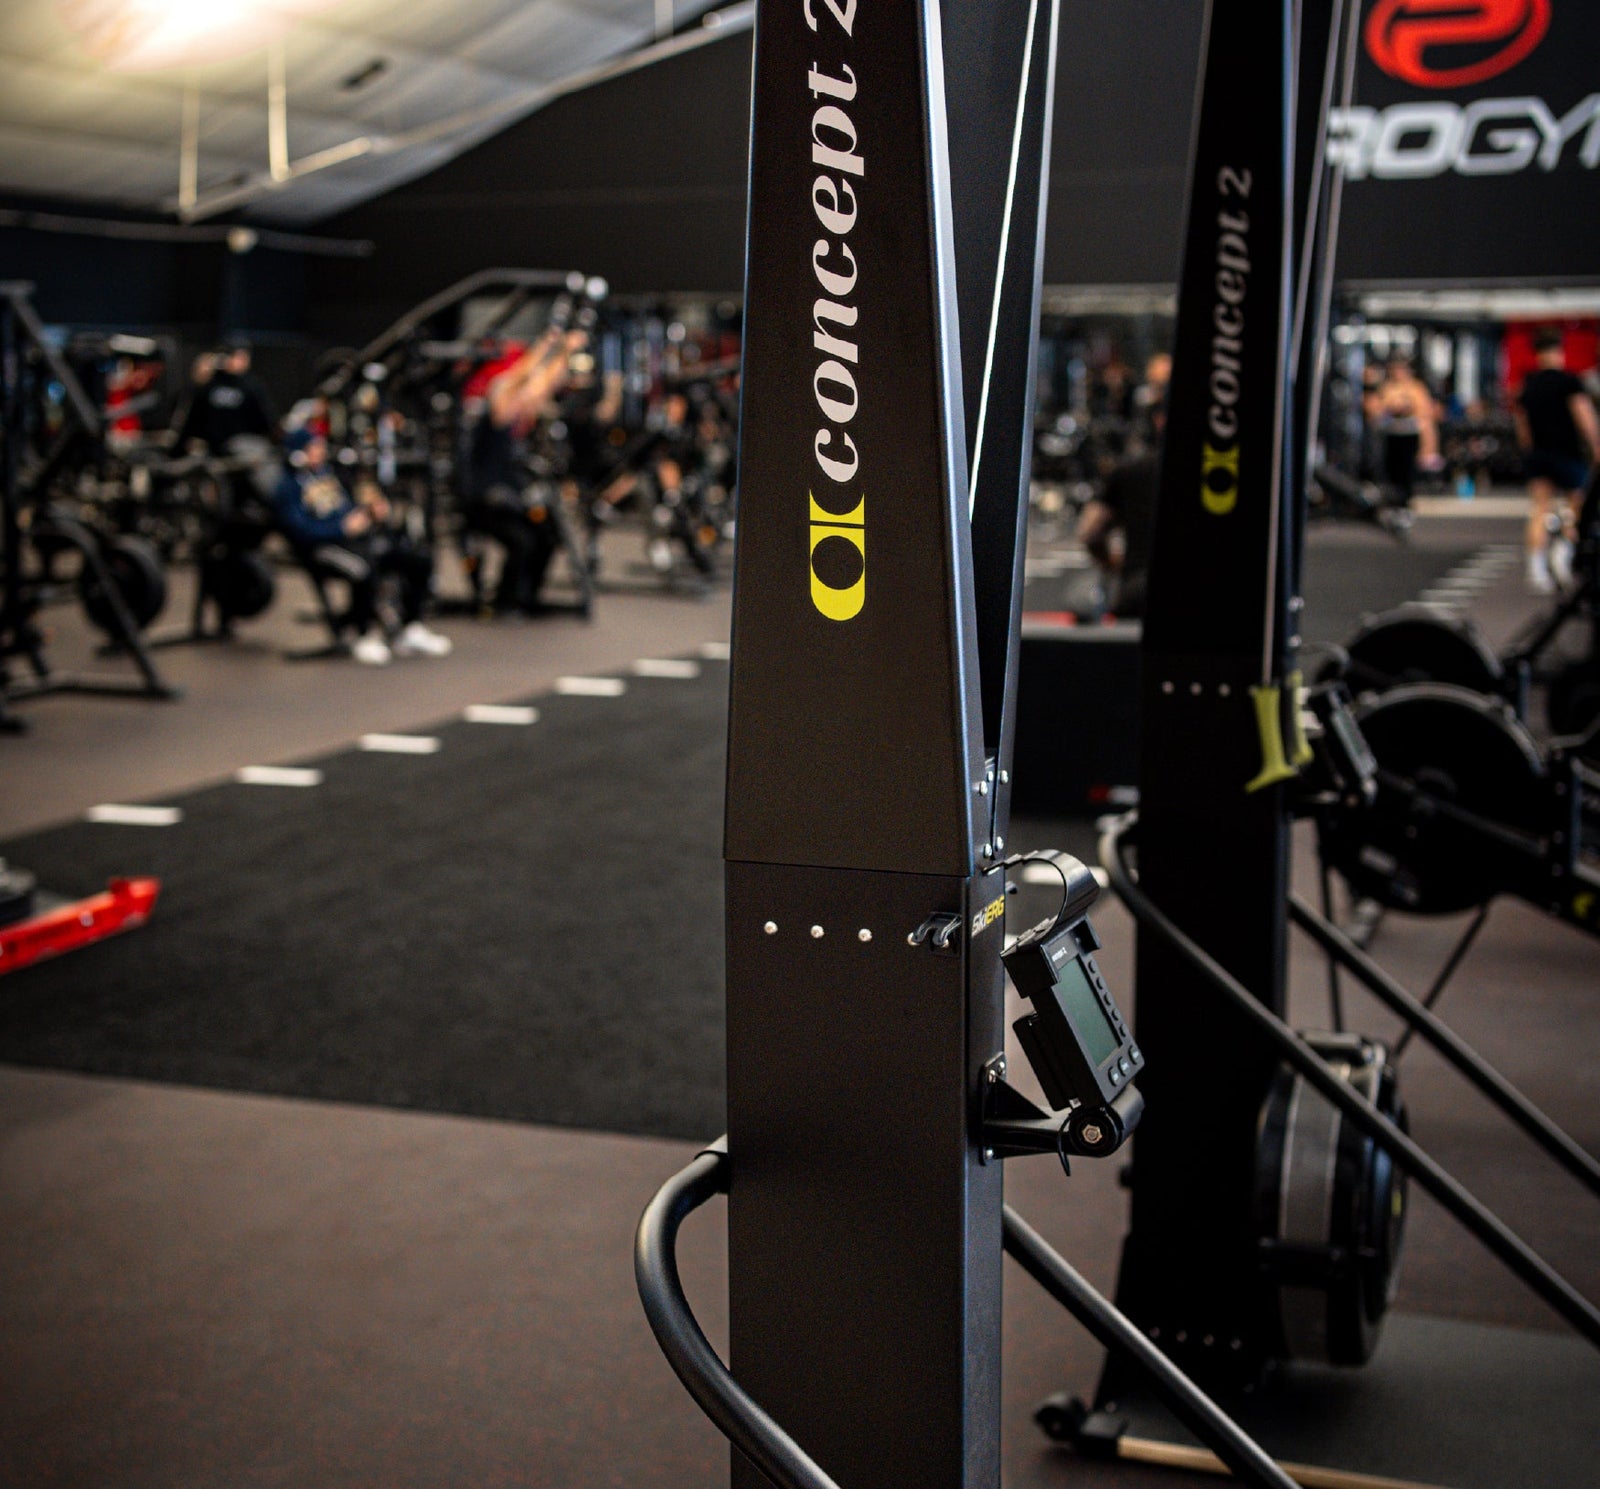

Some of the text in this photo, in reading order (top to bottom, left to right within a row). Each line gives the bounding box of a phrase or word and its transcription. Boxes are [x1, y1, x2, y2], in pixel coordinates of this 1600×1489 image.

[807, 61, 865, 483] concept
[1326, 93, 1600, 180] ROGY
[1207, 165, 1253, 439] concept 2
